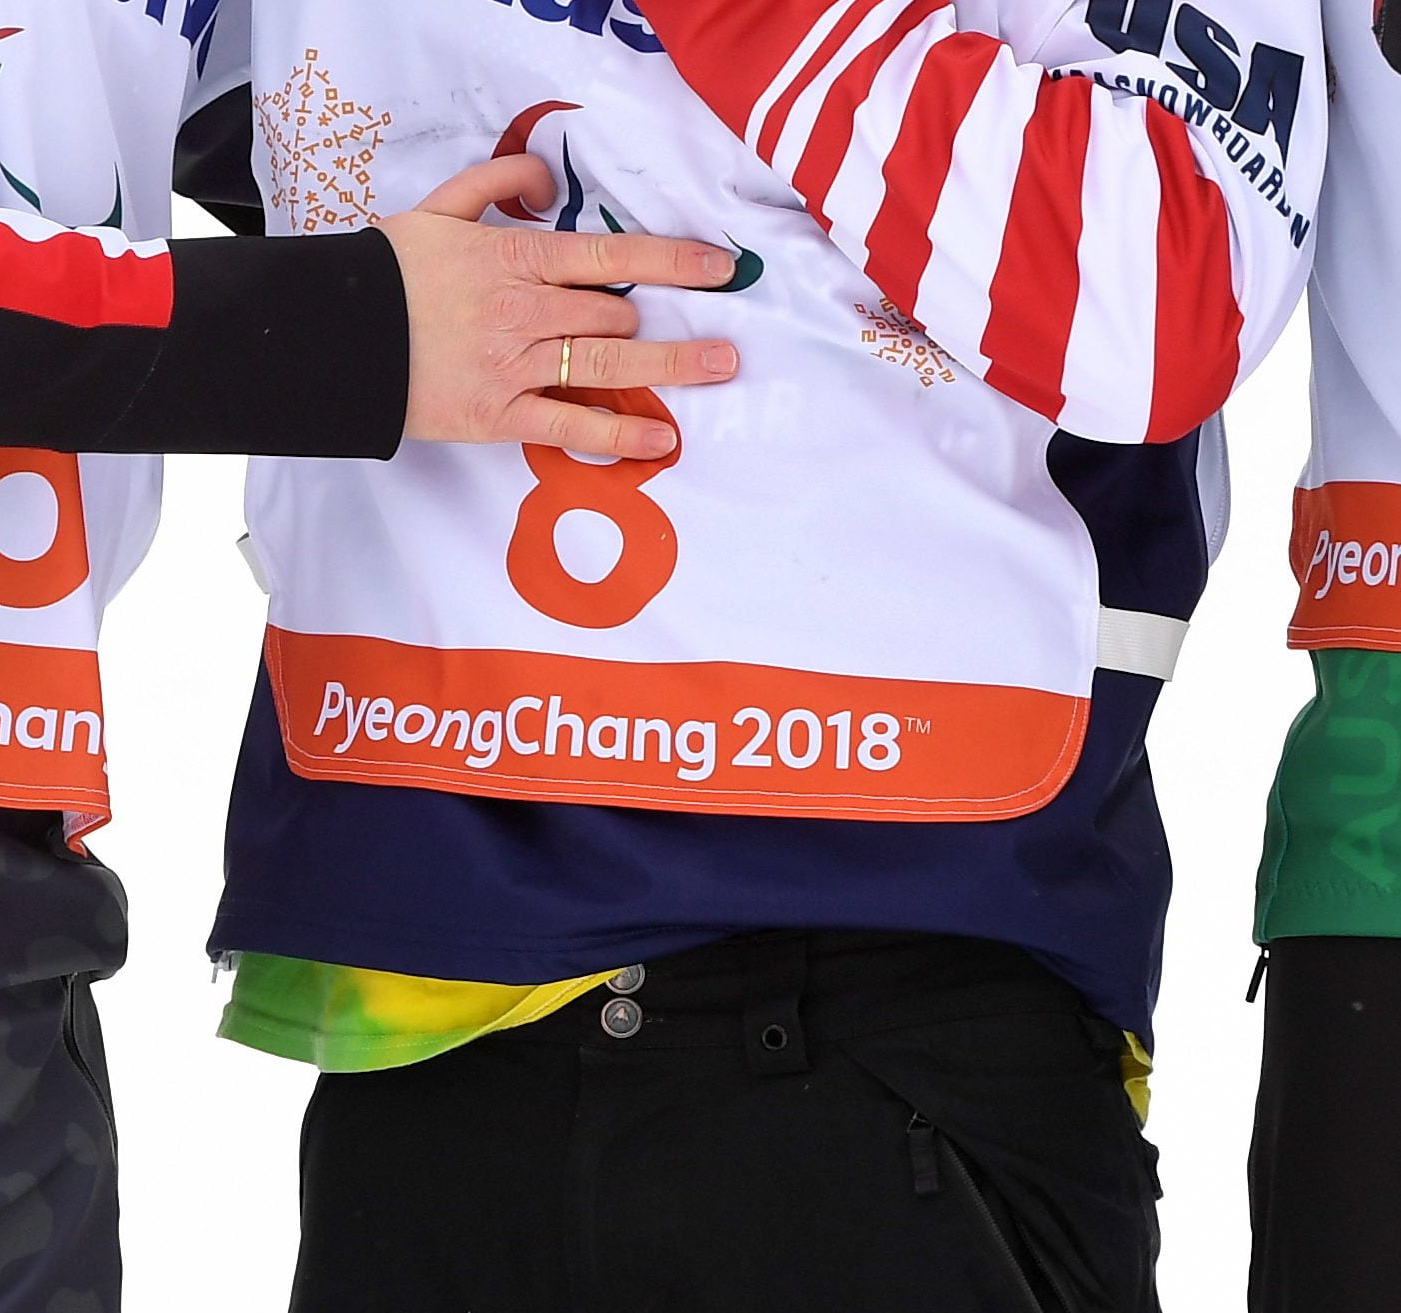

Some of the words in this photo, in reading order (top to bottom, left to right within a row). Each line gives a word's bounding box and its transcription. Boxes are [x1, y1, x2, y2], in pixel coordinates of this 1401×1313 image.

[505, 384, 682, 630] 8
[313, 681, 718, 783] PyeongChang
[731, 706, 903, 772] 2018
